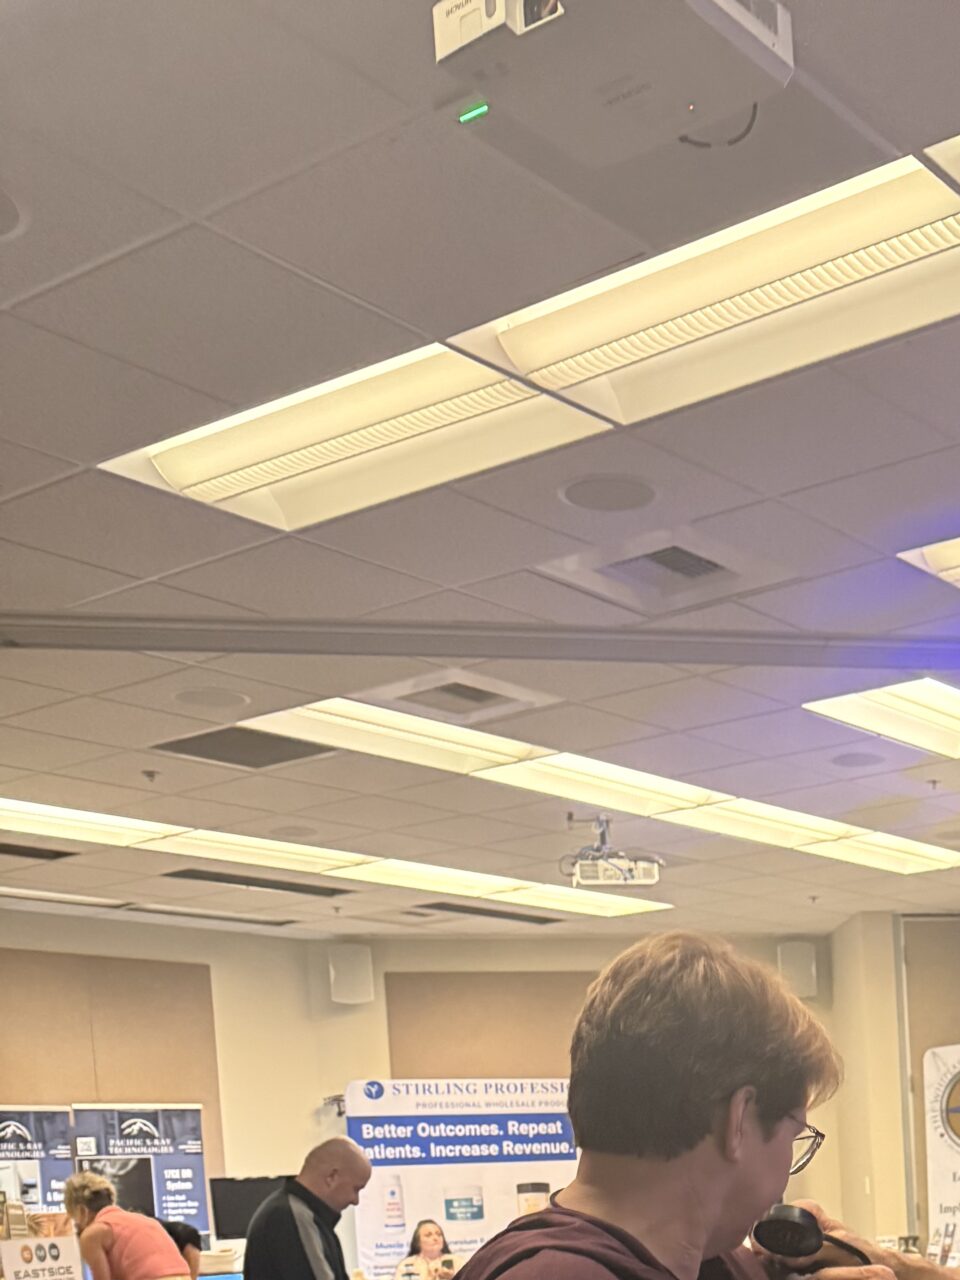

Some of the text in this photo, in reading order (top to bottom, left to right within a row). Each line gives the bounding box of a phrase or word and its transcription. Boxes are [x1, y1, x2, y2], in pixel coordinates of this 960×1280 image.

[392, 1082, 570, 1095] STIRLING PROFESSI
[416, 1101, 482, 1109] PROFESSIONAL
[361, 1120, 563, 1139] Better Outcomes. Repeat
[108, 1146, 174, 1154] TECHNOLOGIES
[430, 1143, 499, 1158] Increase
[502, 1140, 574, 1156] Revenue.
[13, 1265, 74, 1280] EASTSIDE
